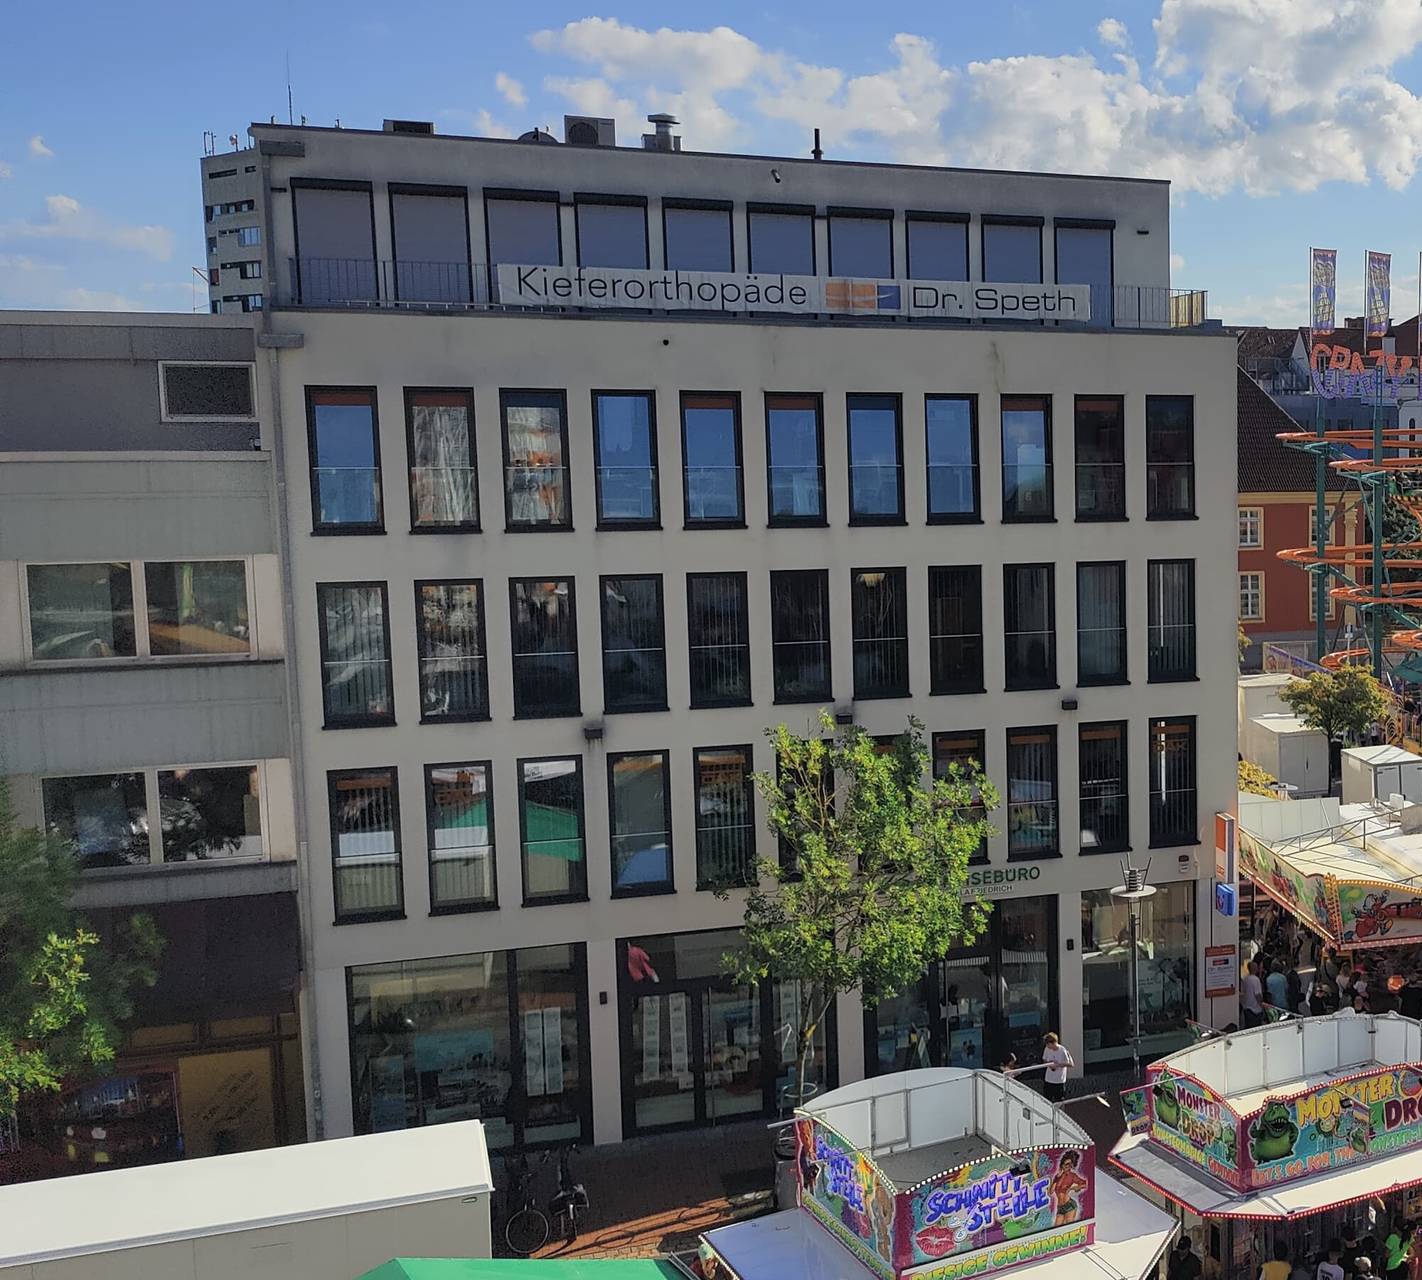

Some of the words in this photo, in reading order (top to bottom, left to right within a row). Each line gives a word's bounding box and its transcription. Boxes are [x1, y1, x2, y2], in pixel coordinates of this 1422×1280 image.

[517, 266, 807, 310] Kieferorthopäde
[913, 286, 964, 309] Dr.
[975, 288, 1076, 317] Speth
[1311, 343, 1412, 400] CRAZY
[966, 866, 1040, 886] ISEBÜRO
[1177, 1085, 1221, 1120] MONSTER
[1181, 1111, 1215, 1146] DROP
[1286, 1160, 1303, 1176] GO
[926, 1171, 1022, 1223] SCHNITT
[967, 1178, 1050, 1232] STELLE
[911, 1255, 990, 1280] RIESIGE
[993, 1225, 1089, 1266] GEWINNE!
